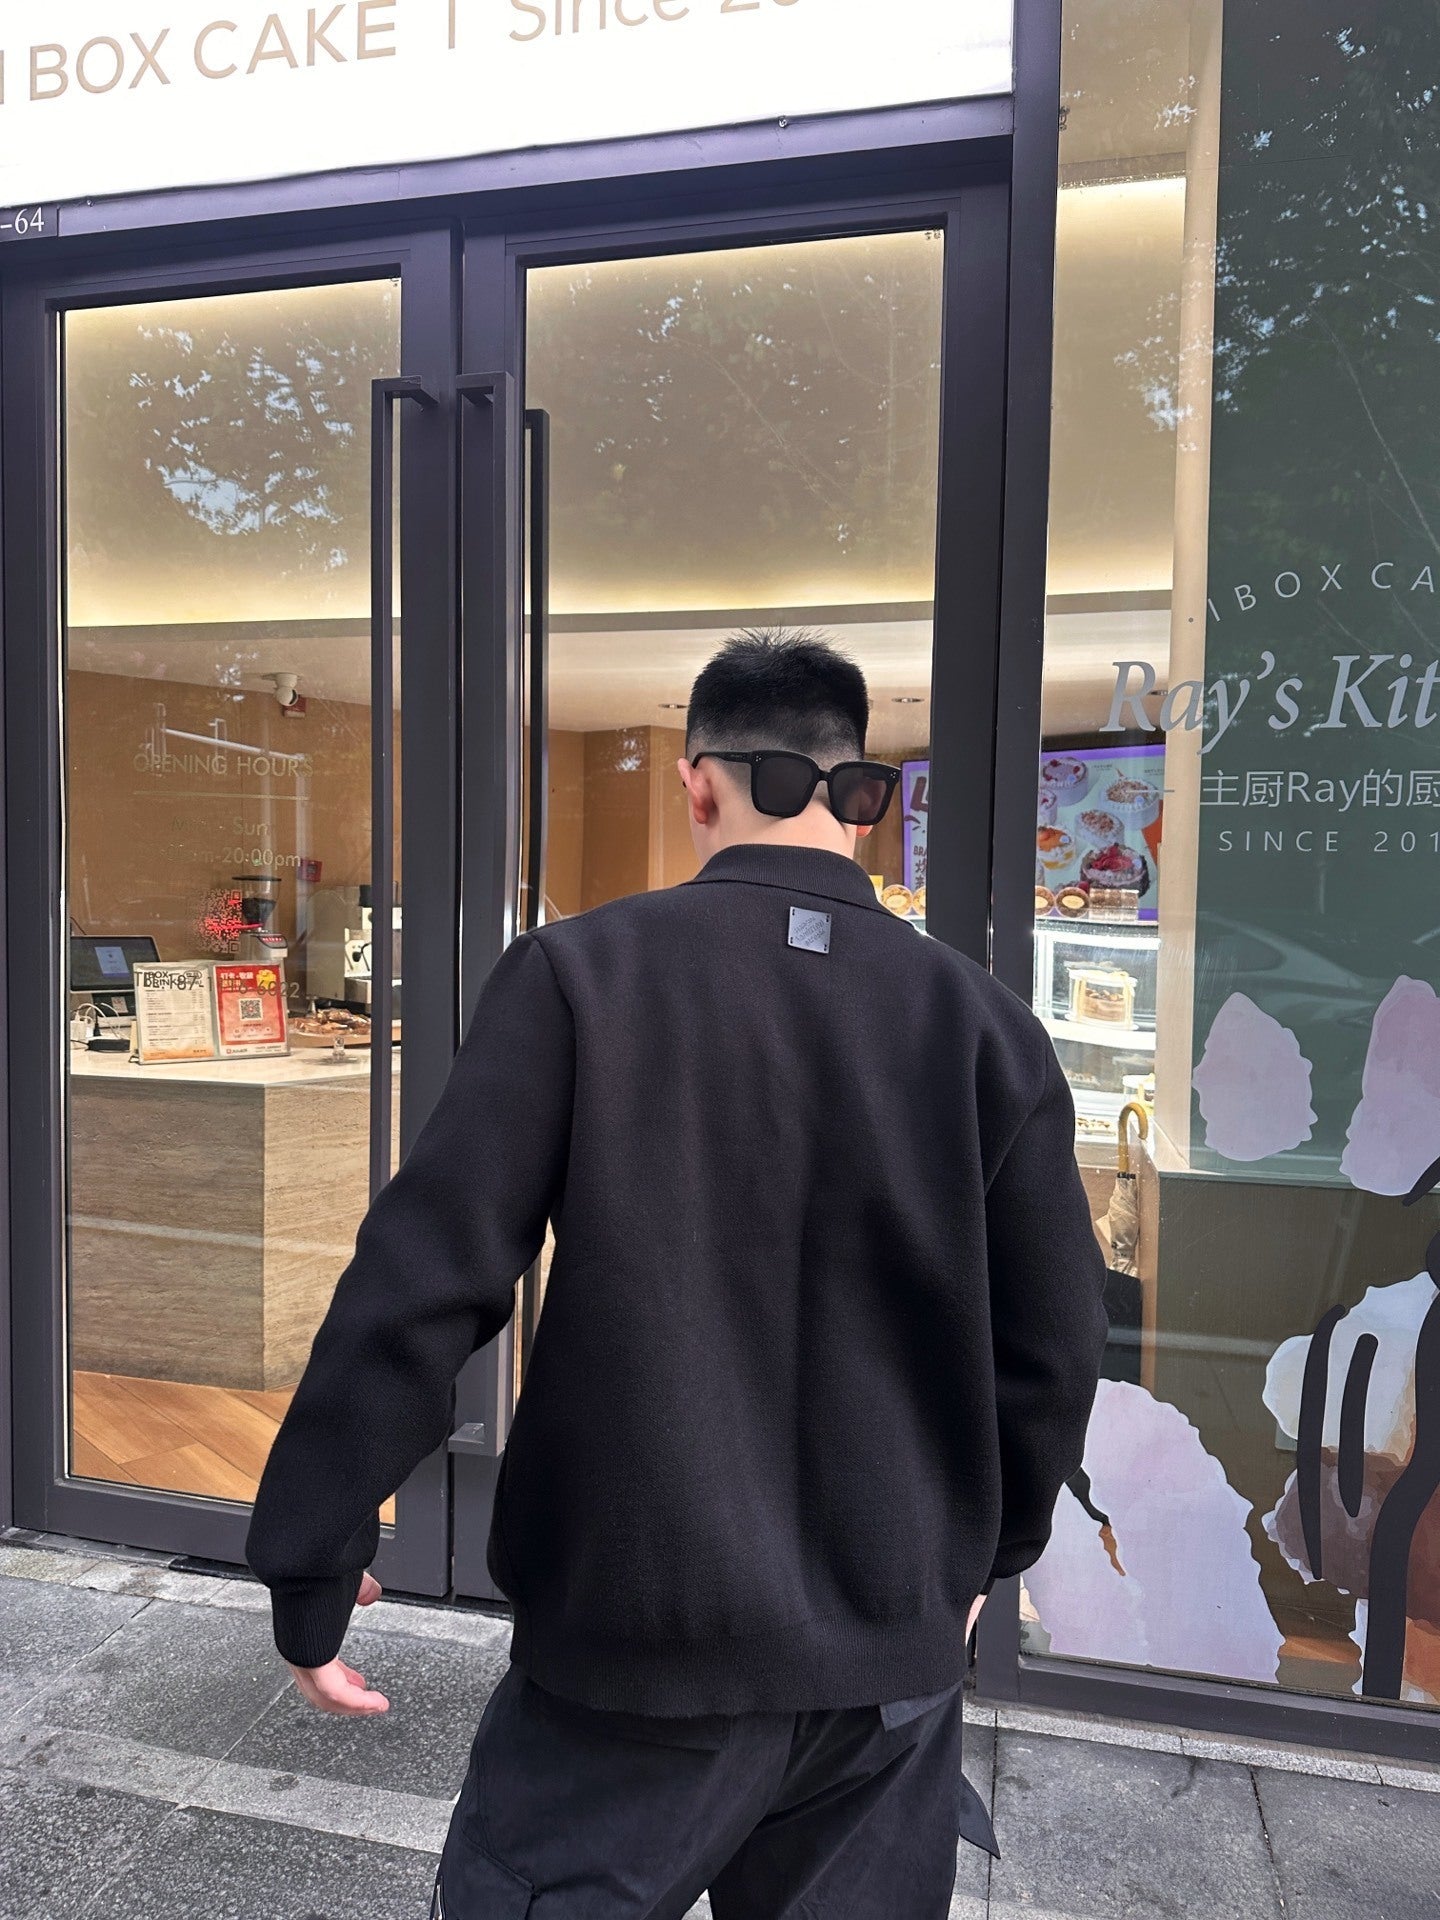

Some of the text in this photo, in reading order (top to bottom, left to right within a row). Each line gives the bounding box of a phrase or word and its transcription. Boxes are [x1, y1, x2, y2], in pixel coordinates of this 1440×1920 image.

[30, 28, 171, 101] BOX
[193, 0, 396, 80] CAKE
[1318, 653, 1440, 729] Kit
[132, 752, 314, 778] OPENING HOURS
[1199, 768, 1440, 812] 主厨Ray的厨
[233, 816, 268, 836] Sun
[1218, 830, 1440, 852] SINCE 201
